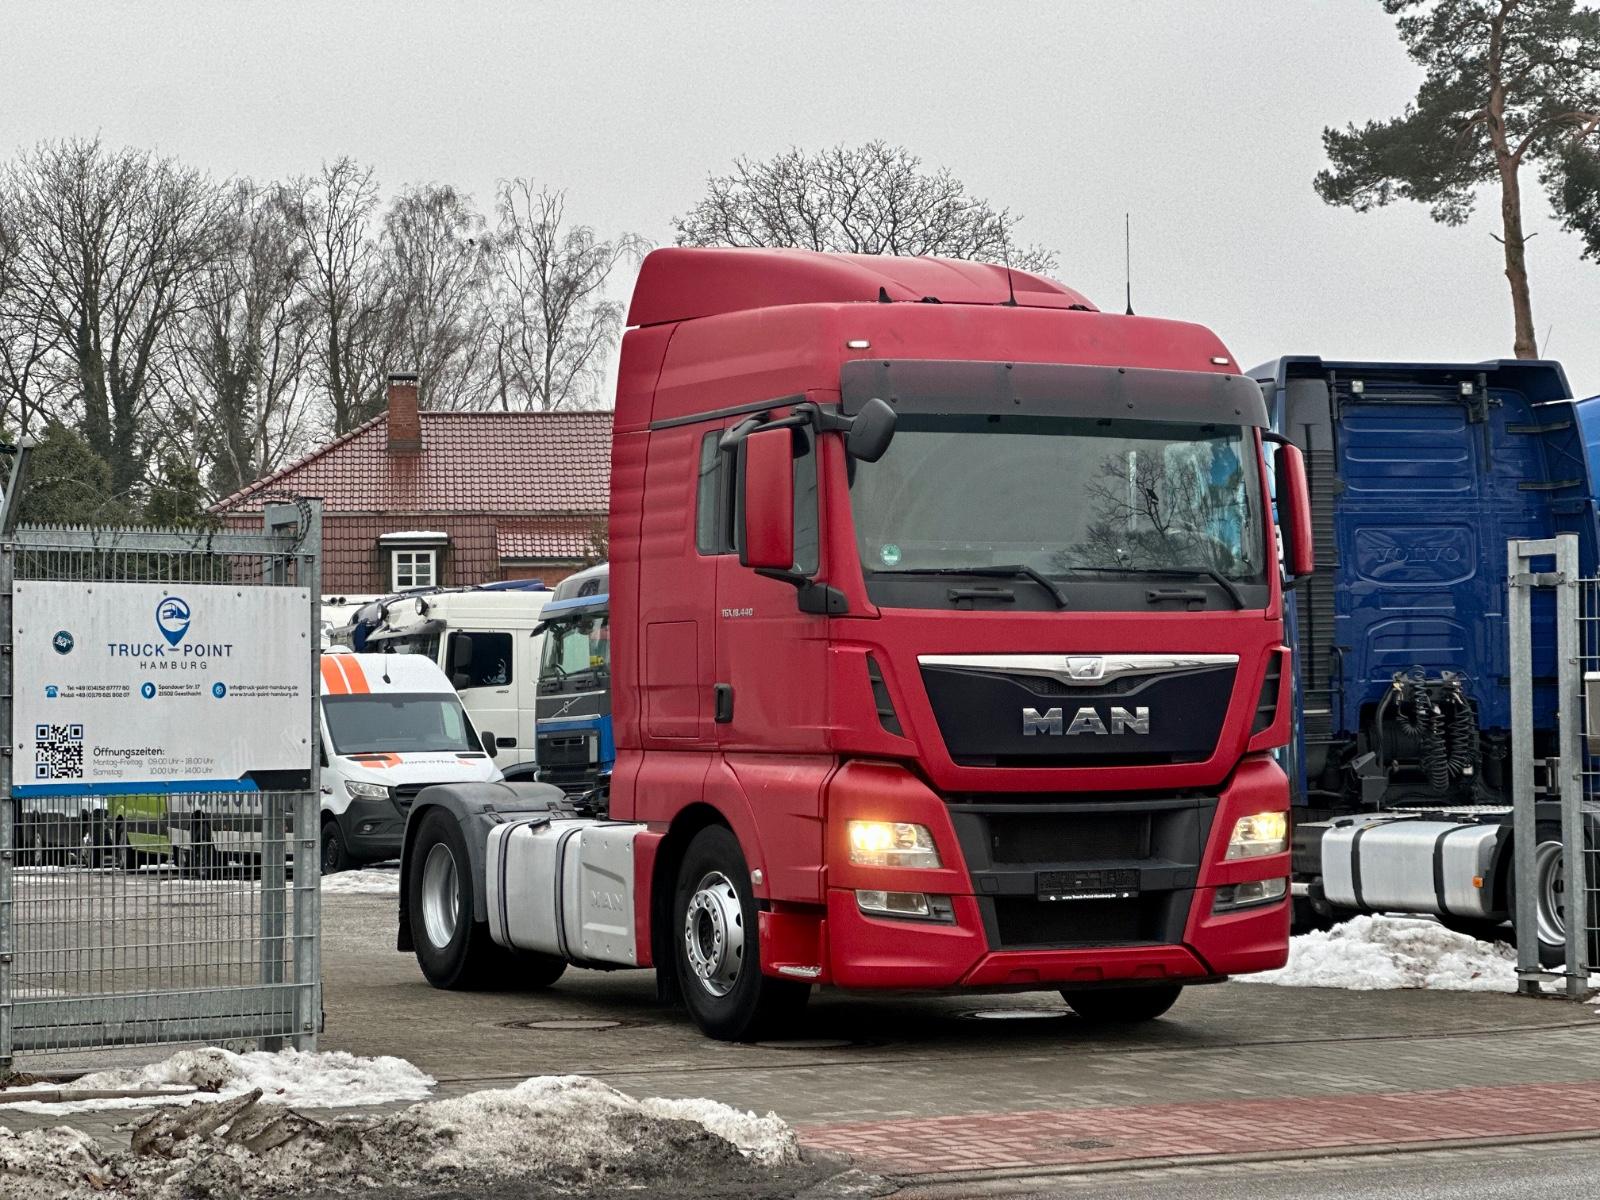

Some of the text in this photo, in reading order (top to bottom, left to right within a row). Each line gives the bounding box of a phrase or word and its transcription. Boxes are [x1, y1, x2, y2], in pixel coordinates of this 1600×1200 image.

[184, 645, 233, 657] POINT
[140, 661, 207, 669] HAMBURG
[1023, 706, 1149, 735] MAN
[93, 746, 165, 759] Öffnungszeiten:
[591, 888, 624, 912] MAN
